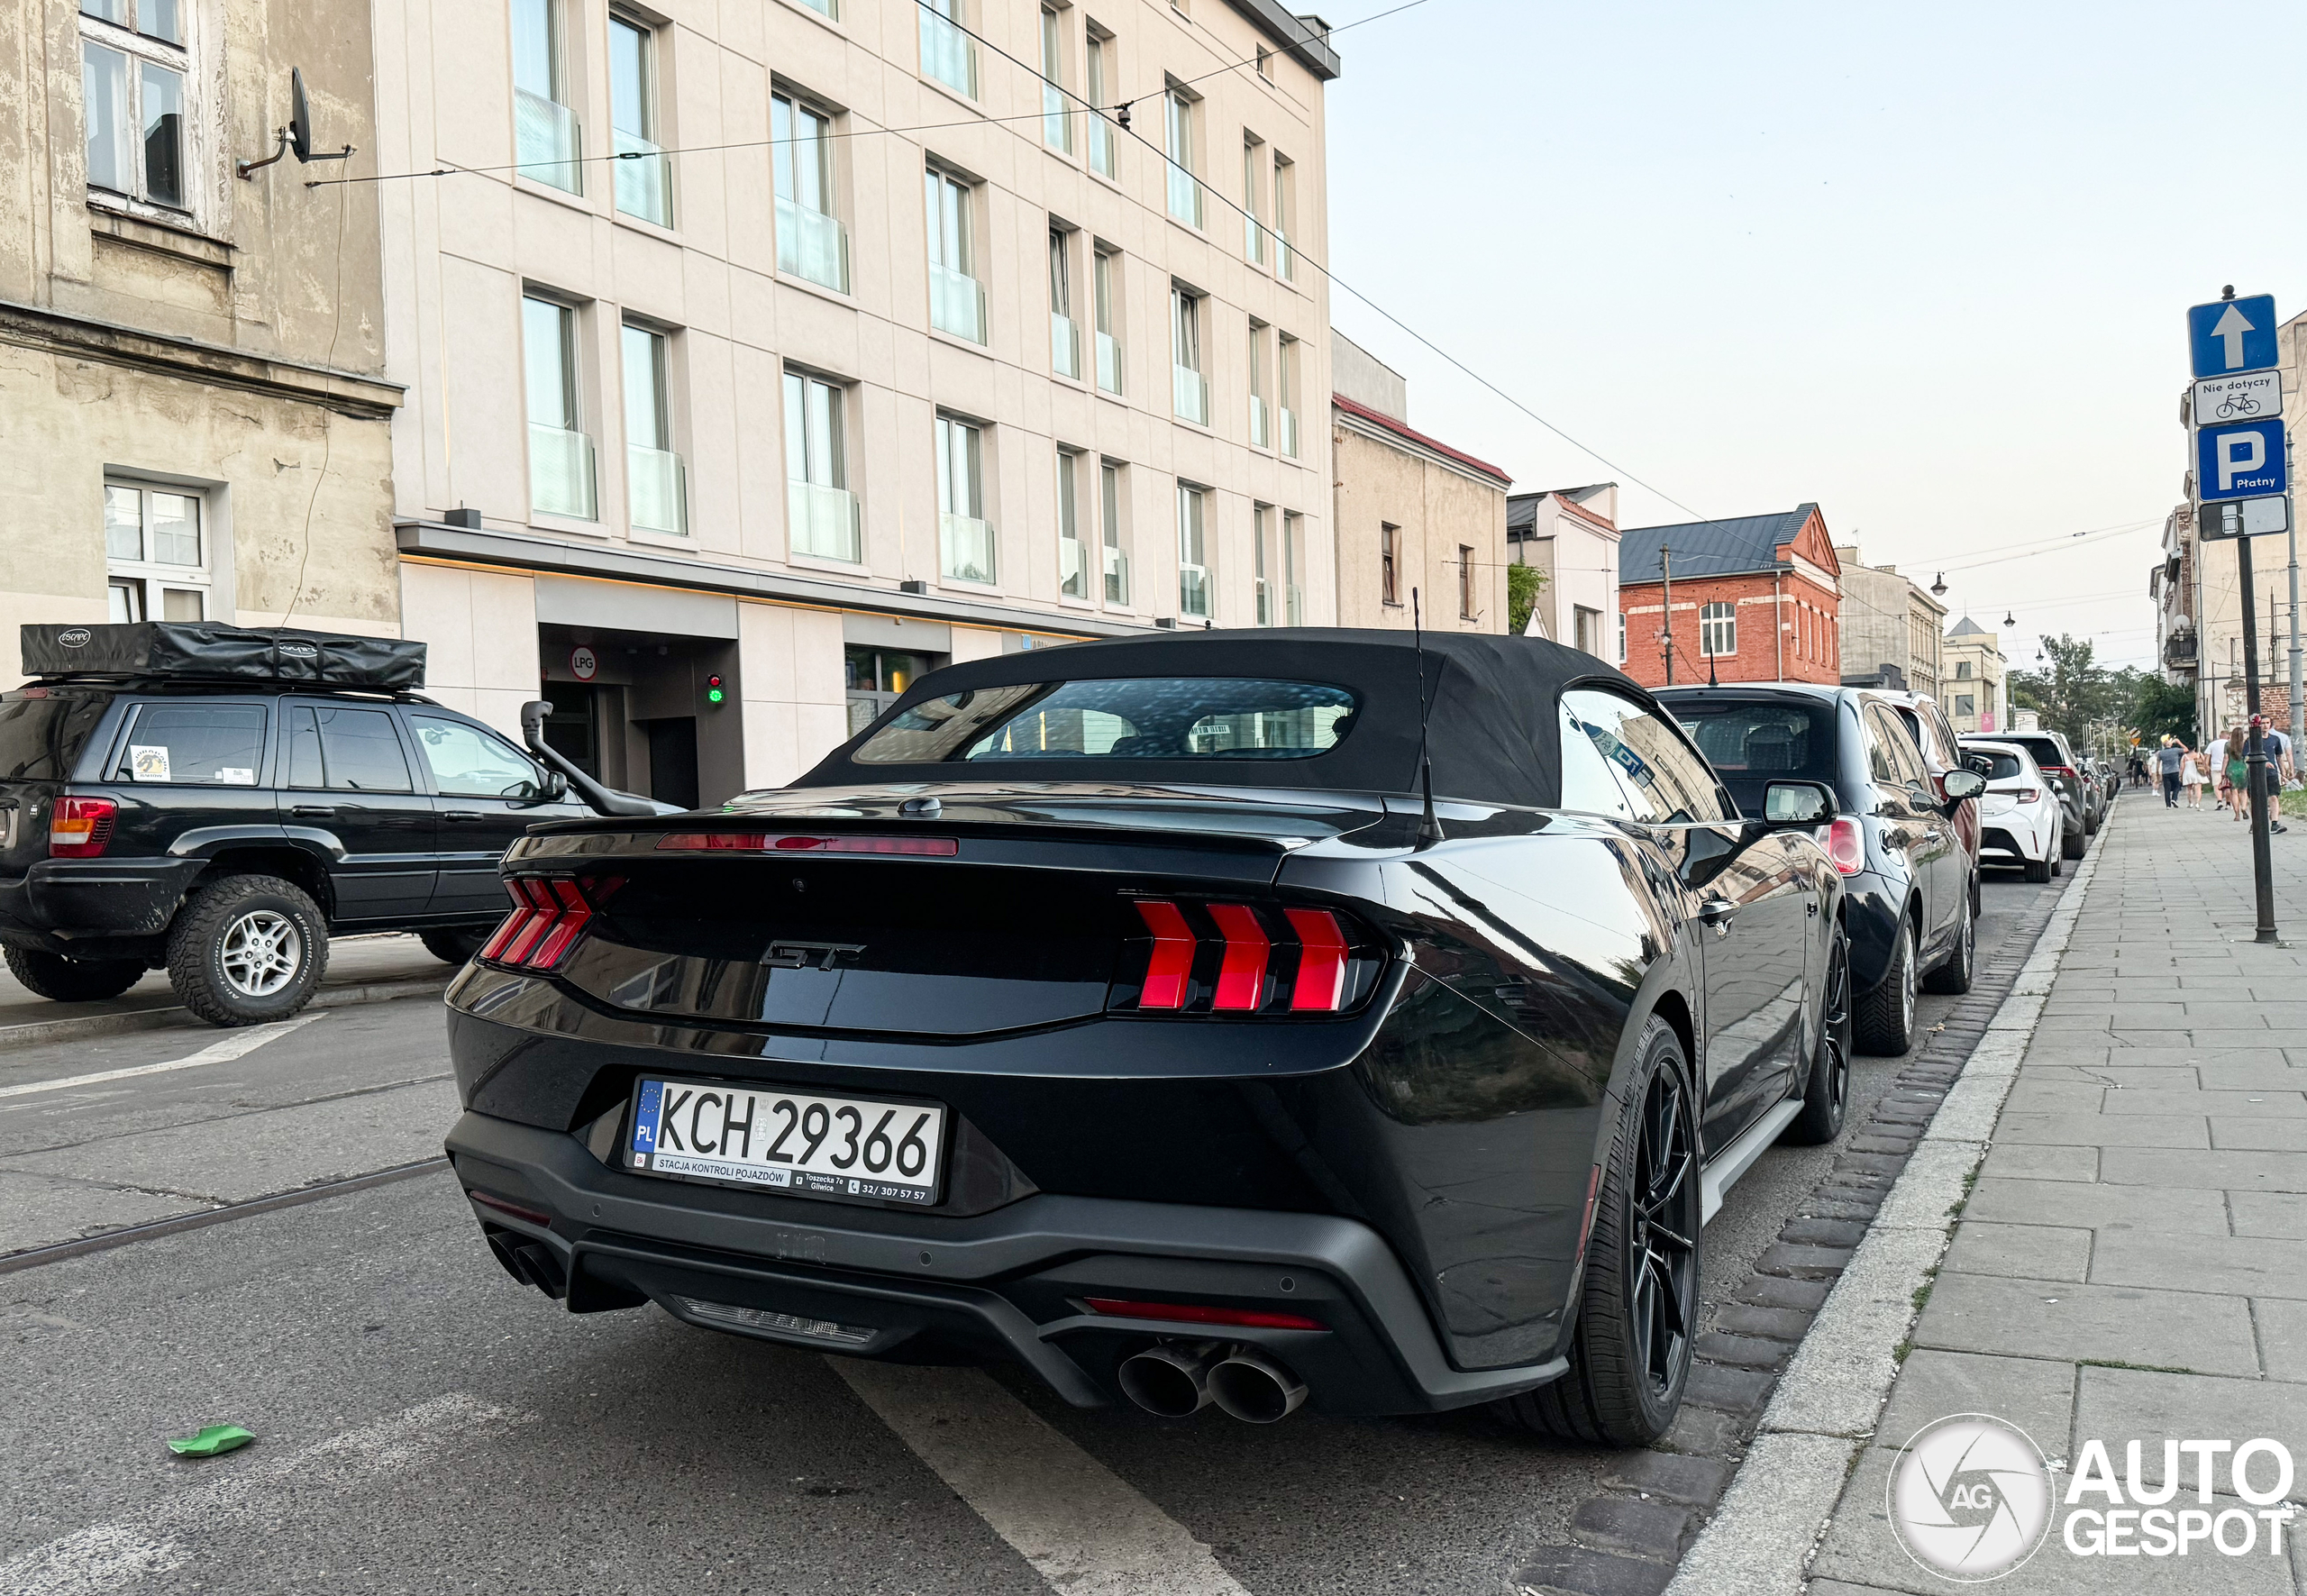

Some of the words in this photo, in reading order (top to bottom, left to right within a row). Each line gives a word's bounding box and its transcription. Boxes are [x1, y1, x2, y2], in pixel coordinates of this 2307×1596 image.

[2203, 383, 2223, 394] Nie
[2227, 378, 2271, 391] dotyczy
[2217, 431, 2266, 491] P
[2237, 477, 2275, 489] Płatny
[574, 656, 593, 669] LPG
[294, 913, 314, 984] BFGoodrich
[759, 940, 868, 971] GT
[636, 1125, 653, 1144] PL
[658, 1088, 756, 1159] KCH
[766, 1099, 932, 1177] 29366
[1627, 1090, 1642, 1179] Continental
[659, 1159, 690, 1171] STACJA
[691, 1163, 734, 1177] KONTROLI
[734, 1168, 784, 1182] POJAZDÓW
[805, 1173, 834, 1184] Toszecka
[810, 1182, 834, 1191] Gliwice
[862, 1184, 879, 1196] 32/
[880, 1187, 898, 1197] 307
[899, 1190, 912, 1199] 57
[914, 1191, 926, 1200] 57
